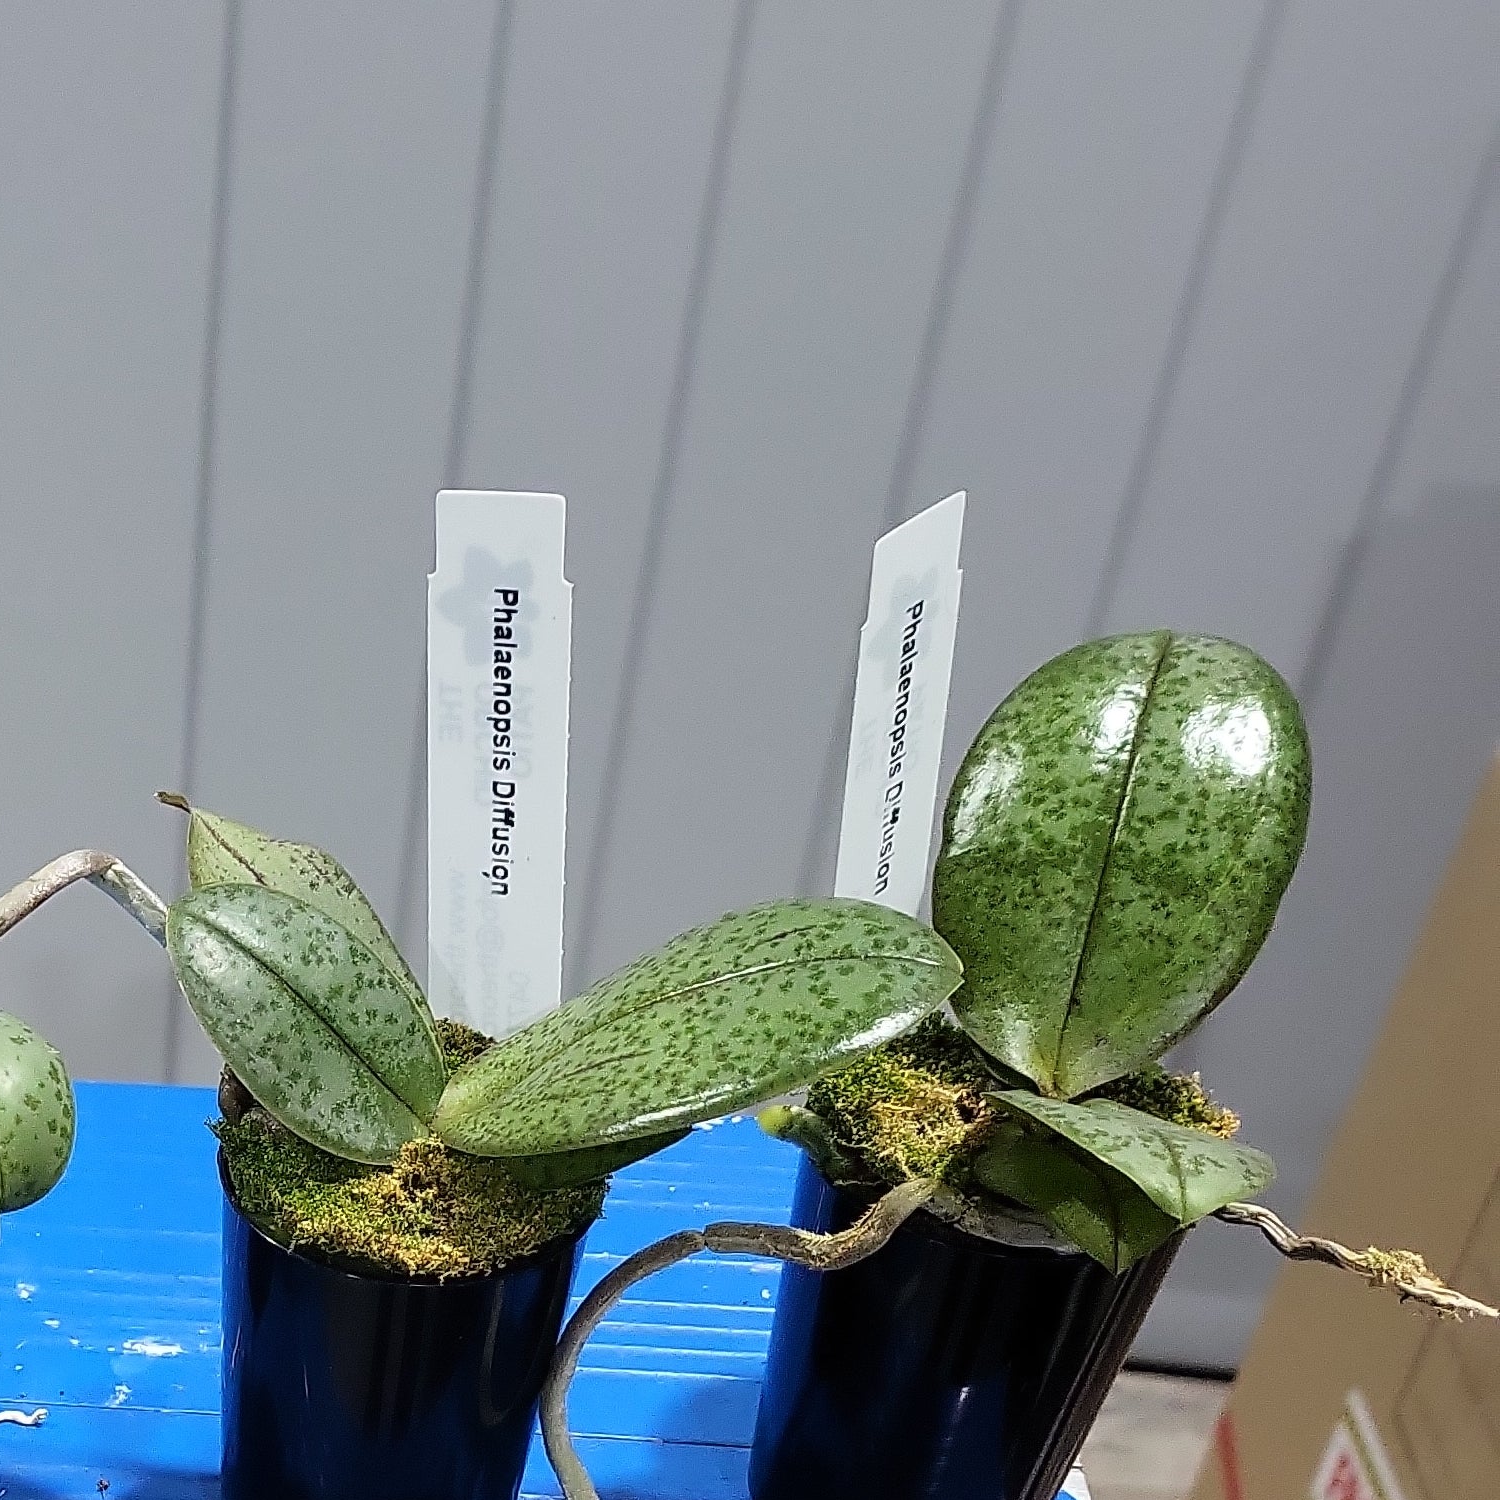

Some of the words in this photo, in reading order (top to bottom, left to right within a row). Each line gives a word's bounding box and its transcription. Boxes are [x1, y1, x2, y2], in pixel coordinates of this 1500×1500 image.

[486, 588, 519, 771] Phalaenopsis
[886, 599, 924, 778] Phalaenopsis
[491, 780, 517, 896] Diffusion
[874, 779, 905, 896] Diffusion
